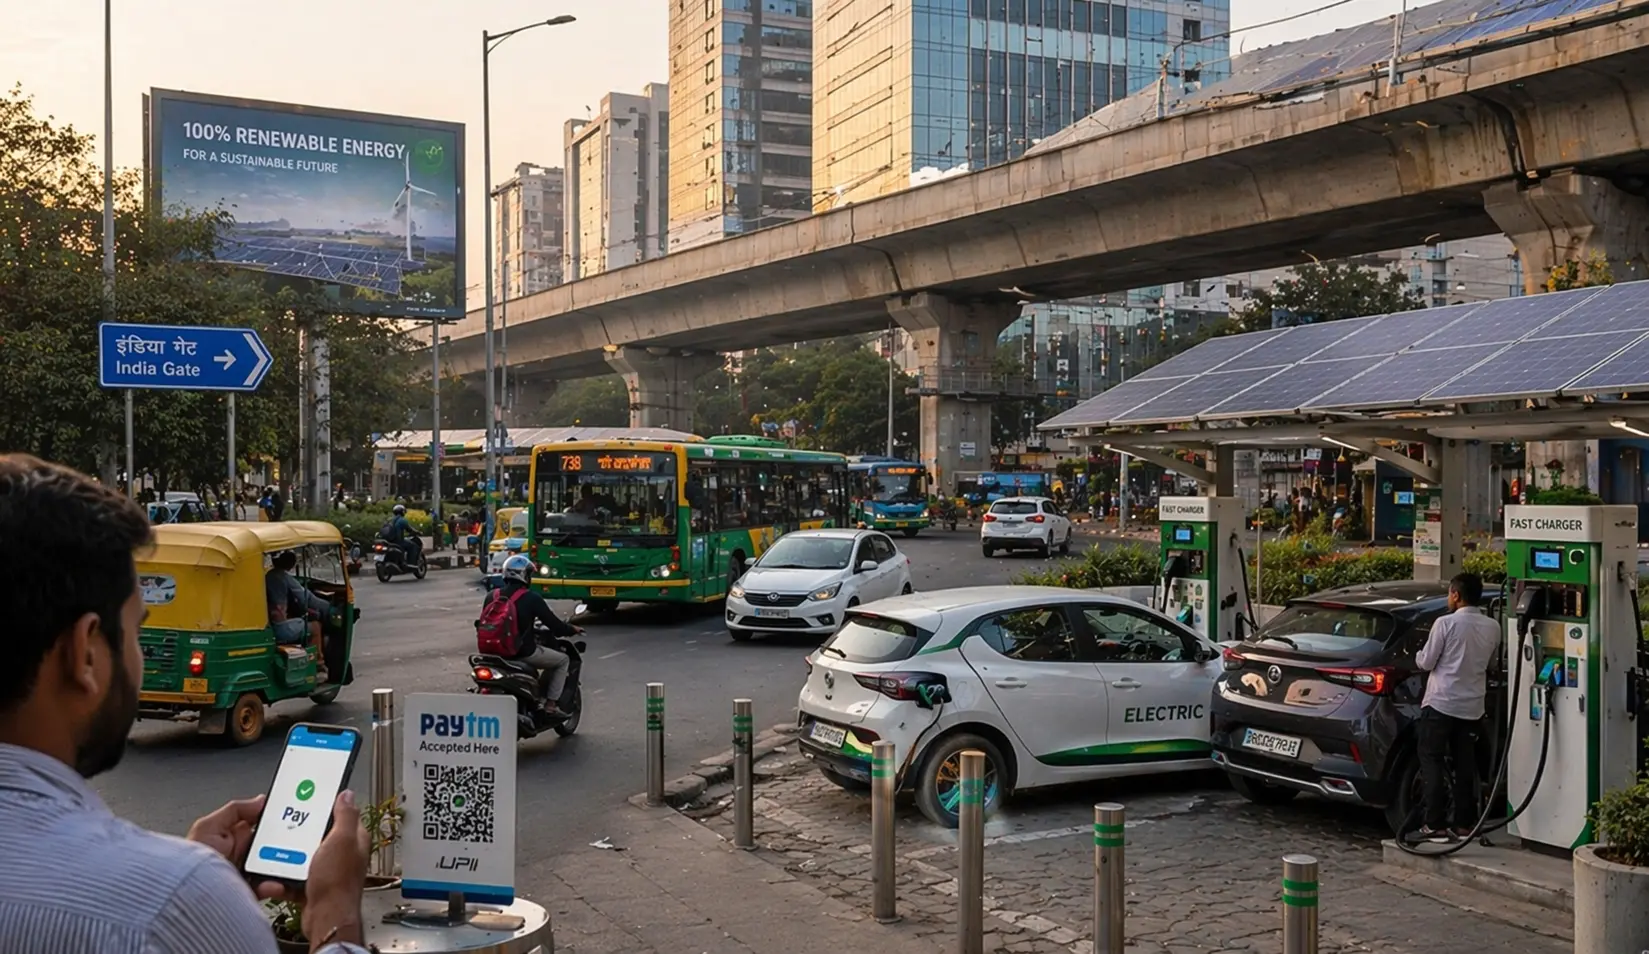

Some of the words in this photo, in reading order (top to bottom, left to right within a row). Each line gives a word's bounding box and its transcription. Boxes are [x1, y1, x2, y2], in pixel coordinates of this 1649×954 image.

[183, 121, 231, 142] 100%
[236, 127, 338, 153] RENEWABLE
[343, 138, 405, 160] ENERGY
[183, 148, 206, 161] FOR
[209, 151, 218, 162] A
[220, 152, 294, 170] SUSTAINABLE
[296, 160, 338, 174] FUTURE
[115, 334, 166, 357] इंडिया
[172, 335, 198, 356] गेट
[116, 360, 157, 375] India
[162, 361, 201, 377] Gate
[561, 455, 582, 470] 738
[1161, 505, 1176, 513] FAST
[1176, 506, 1205, 514] CHARGER
[1510, 518, 1533, 529] FAST
[1535, 519, 1583, 531] CHARGER
[1124, 704, 1204, 723] ELECTRIC
[419, 740, 471, 754] Accepted
[473, 742, 500, 755] Here
[282, 806, 310, 827] Pay
